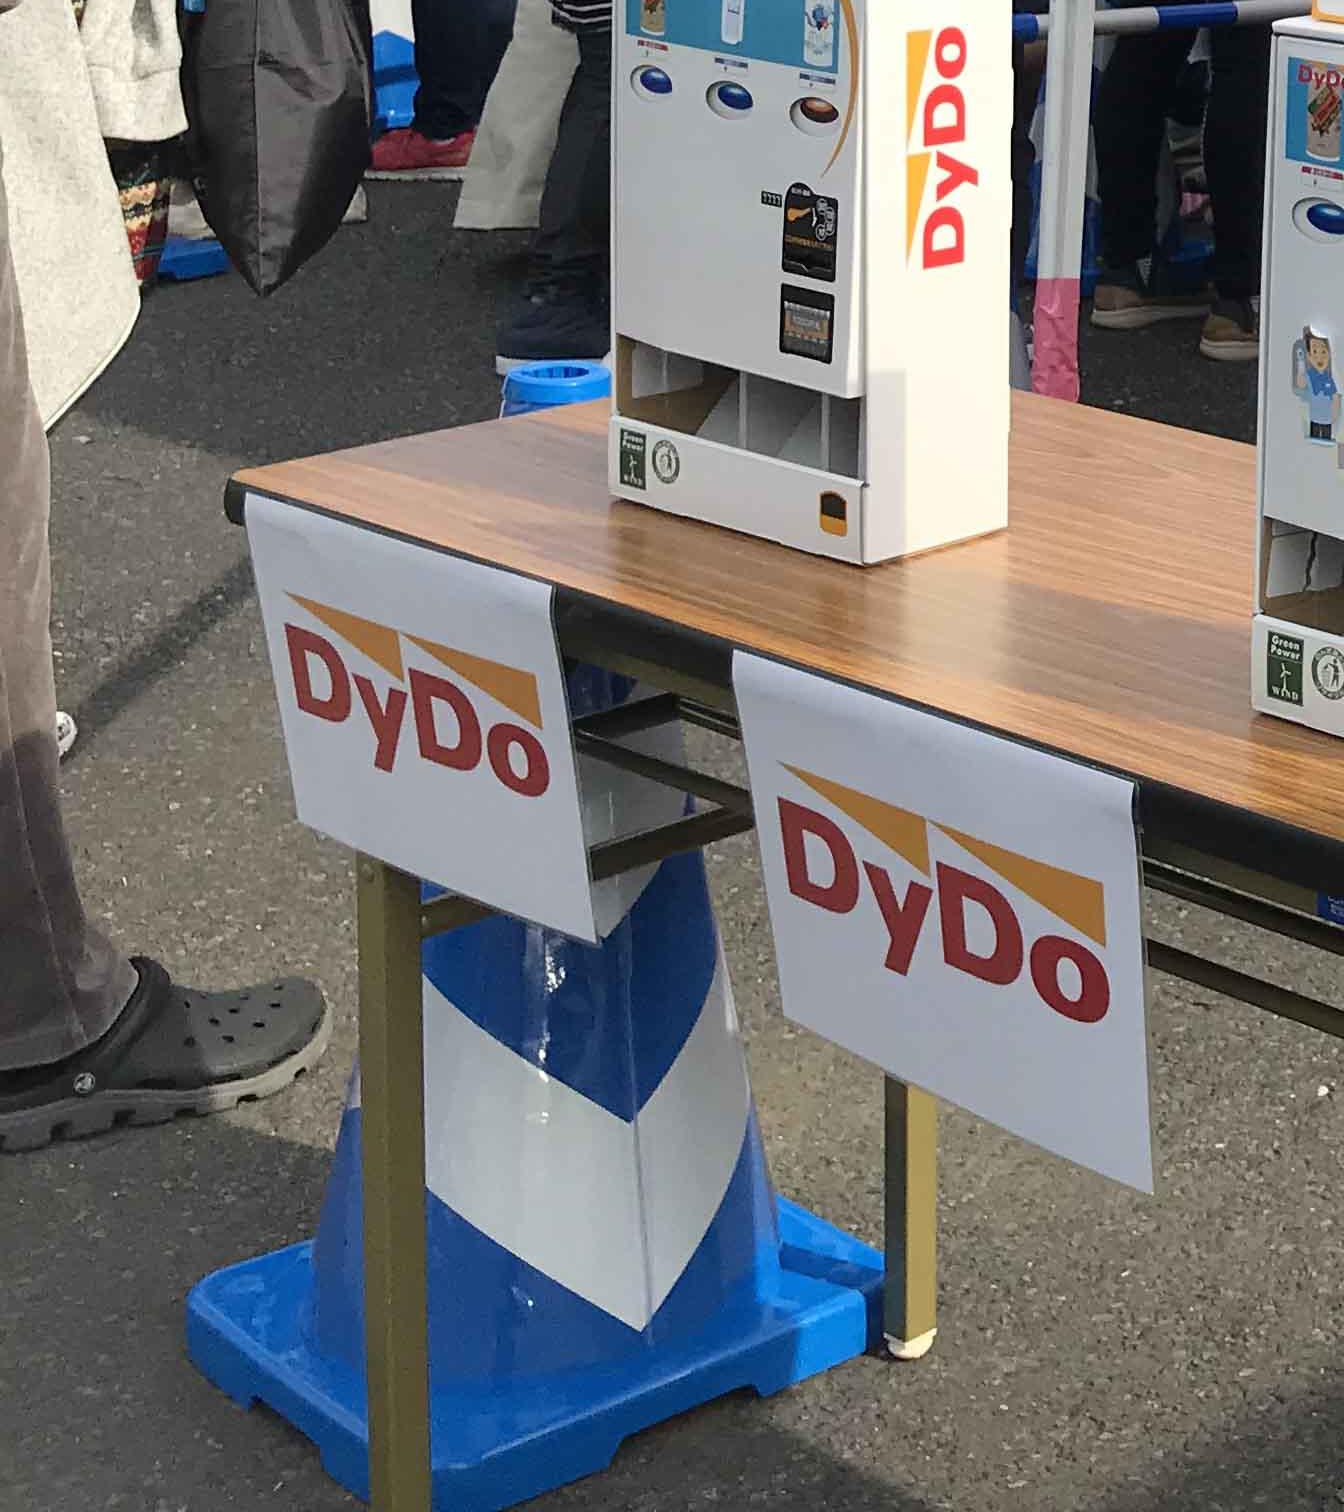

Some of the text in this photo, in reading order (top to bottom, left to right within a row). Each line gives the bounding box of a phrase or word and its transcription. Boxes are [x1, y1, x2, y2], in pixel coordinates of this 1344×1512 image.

[922, 27, 978, 270] DyDo
[283, 622, 551, 799] DyDo
[776, 795, 1112, 1025] DyDo
